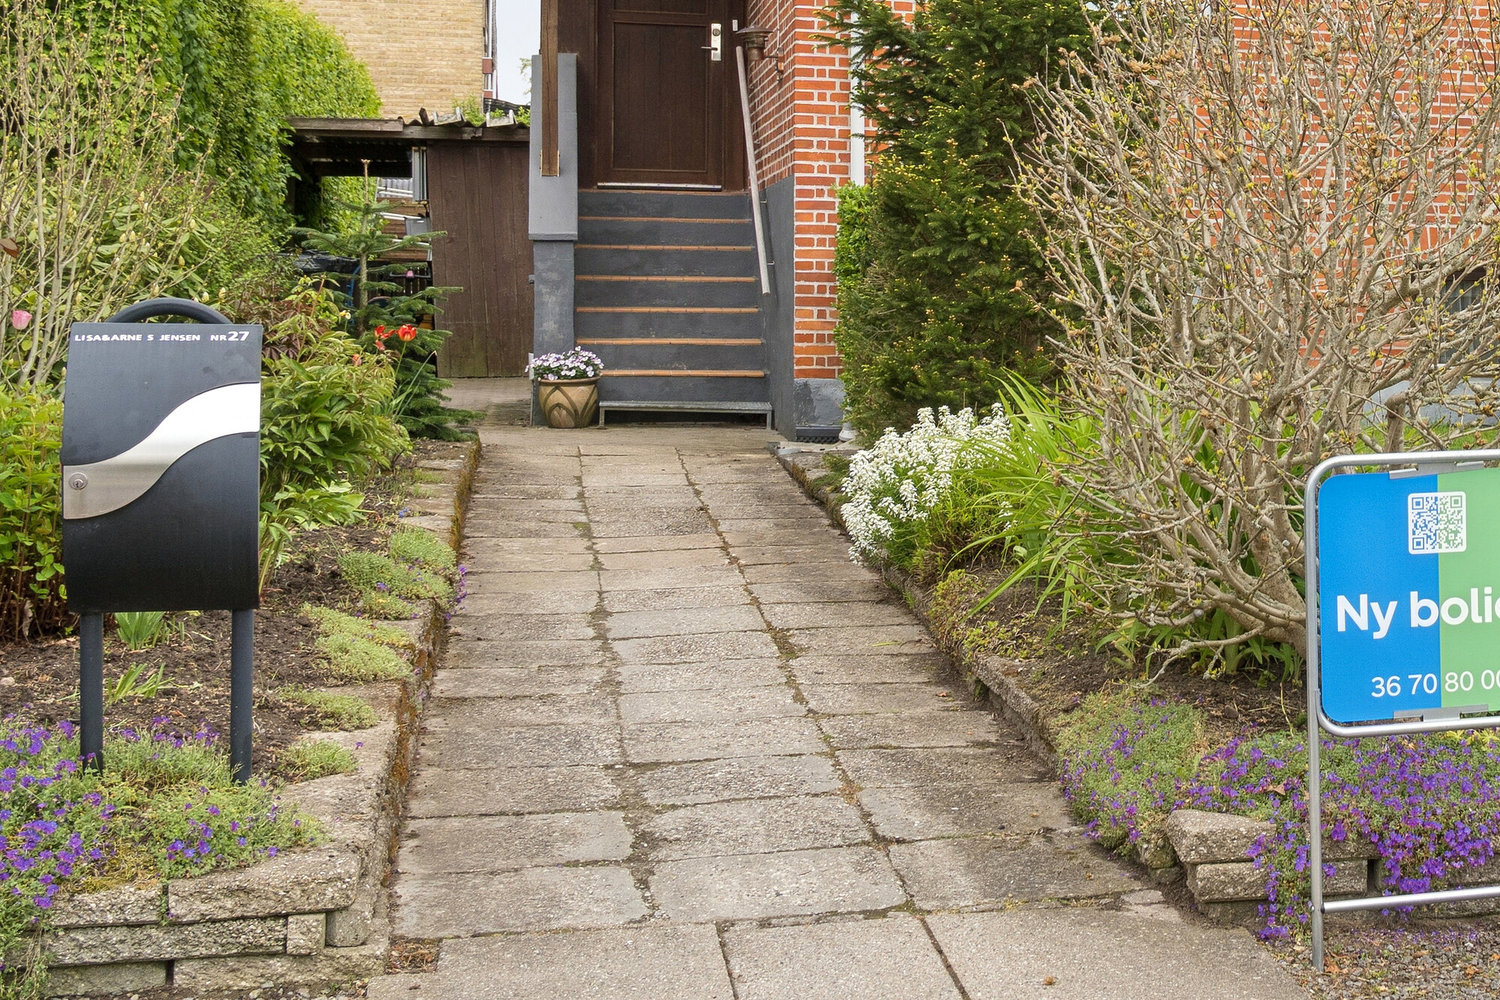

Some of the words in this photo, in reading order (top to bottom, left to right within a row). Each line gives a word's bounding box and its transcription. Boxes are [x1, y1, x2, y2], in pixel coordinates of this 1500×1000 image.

[147, 334, 155, 342] S
[159, 334, 201, 342] JENSEN
[1336, 593, 1398, 639] Ny
[1371, 675, 1401, 698] 36
[1408, 673, 1438, 695] 70
[1444, 670, 1474, 693] 80
